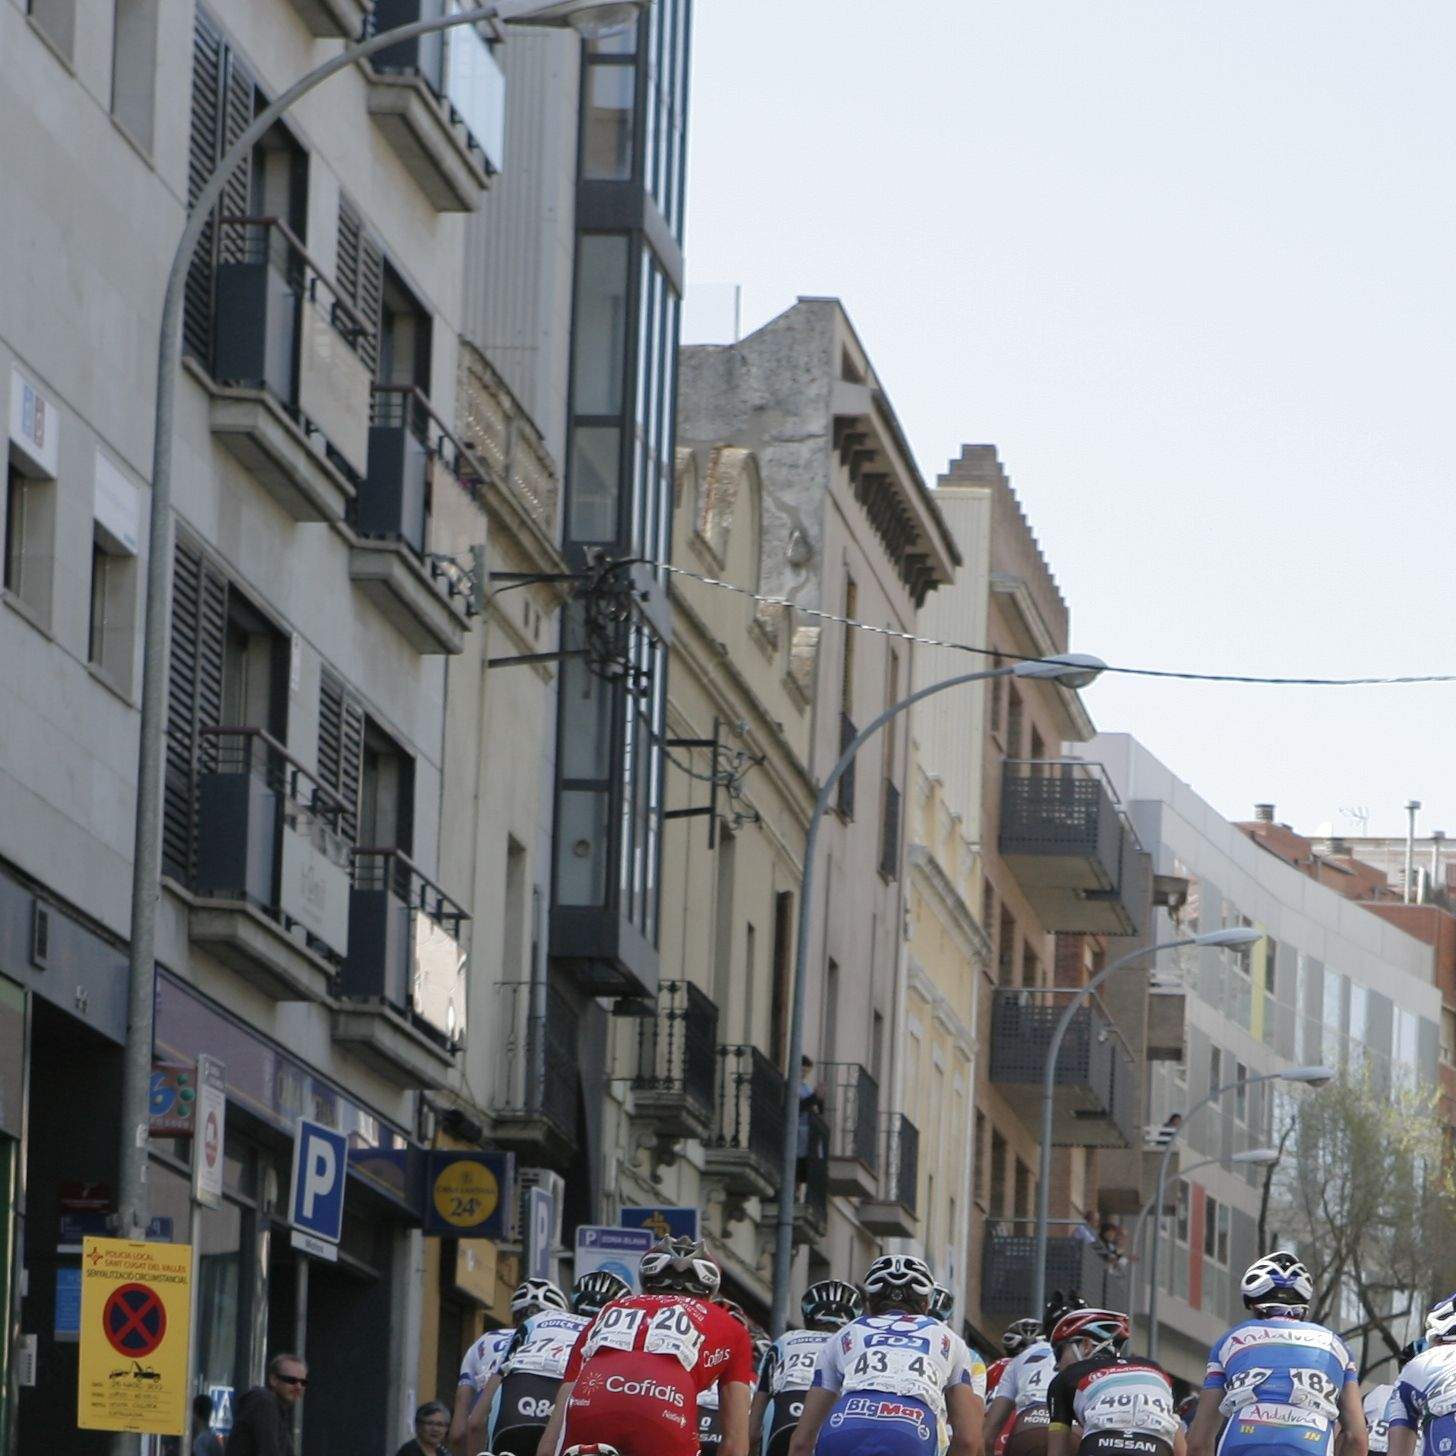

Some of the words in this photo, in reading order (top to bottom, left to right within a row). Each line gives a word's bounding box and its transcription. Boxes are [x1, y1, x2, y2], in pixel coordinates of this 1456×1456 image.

[302, 1135, 336, 1219] P
[540, 1319, 575, 1329] QUICK
[870, 1334, 924, 1347] FDJ
[854, 1350, 889, 1376] 43
[606, 1375, 685, 1408] Cofidis
[1292, 1371, 1337, 1403] 182
[845, 1398, 925, 1421] BigMat
[1098, 1437, 1157, 1453] NISSAN
